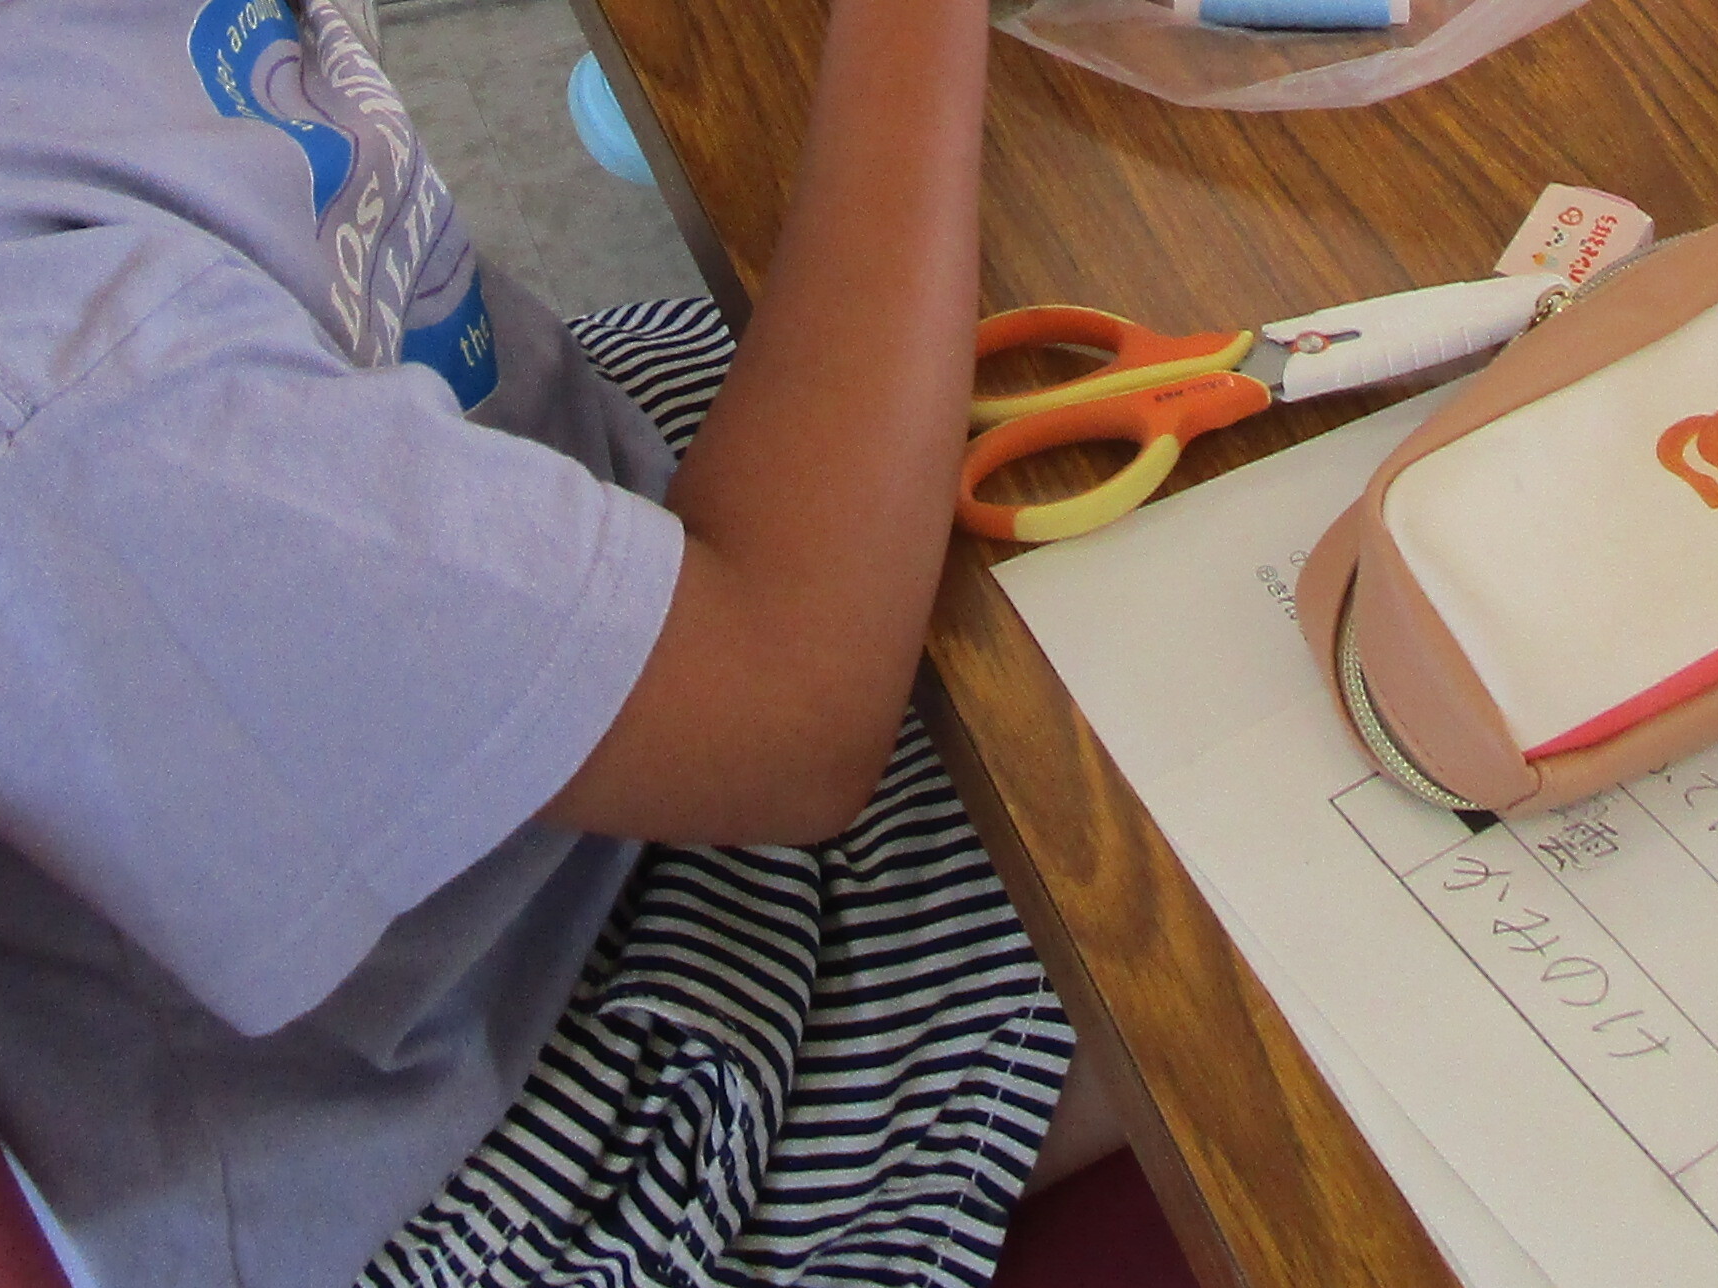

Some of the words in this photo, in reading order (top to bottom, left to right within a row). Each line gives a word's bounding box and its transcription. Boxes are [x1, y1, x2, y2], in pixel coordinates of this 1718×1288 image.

[1567, 211, 1621, 286] パンどろぼう
[1441, 854, 1673, 1064] かみのけ
